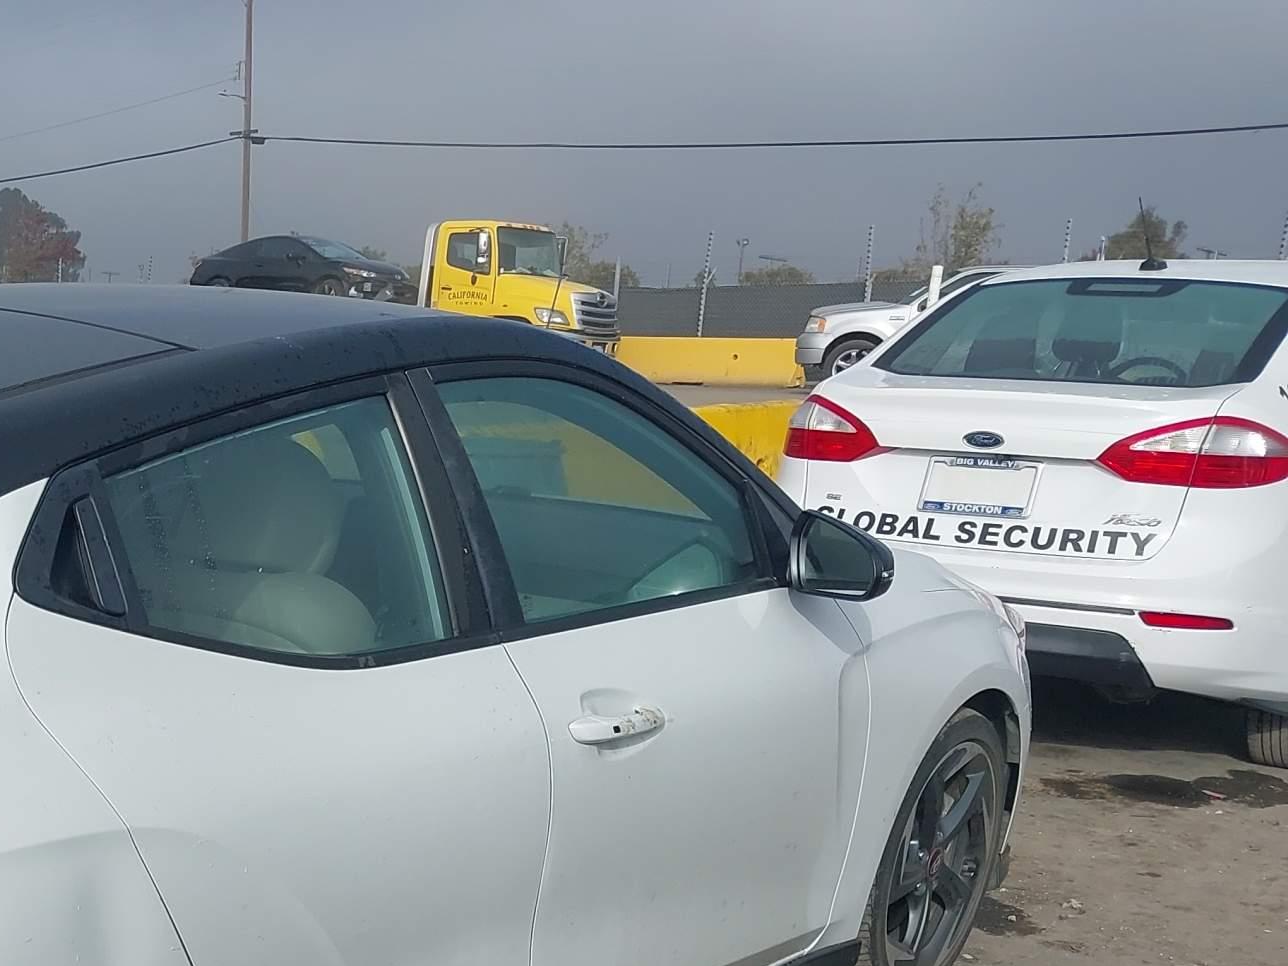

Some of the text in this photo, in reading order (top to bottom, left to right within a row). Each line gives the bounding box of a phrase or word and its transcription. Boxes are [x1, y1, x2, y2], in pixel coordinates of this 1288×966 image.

[448, 290, 487, 301] CALIFORNIA
[977, 459, 1015, 468] VALLEY
[943, 503, 1003, 514] STOCKTON
[954, 521, 1157, 556] SECURITY
